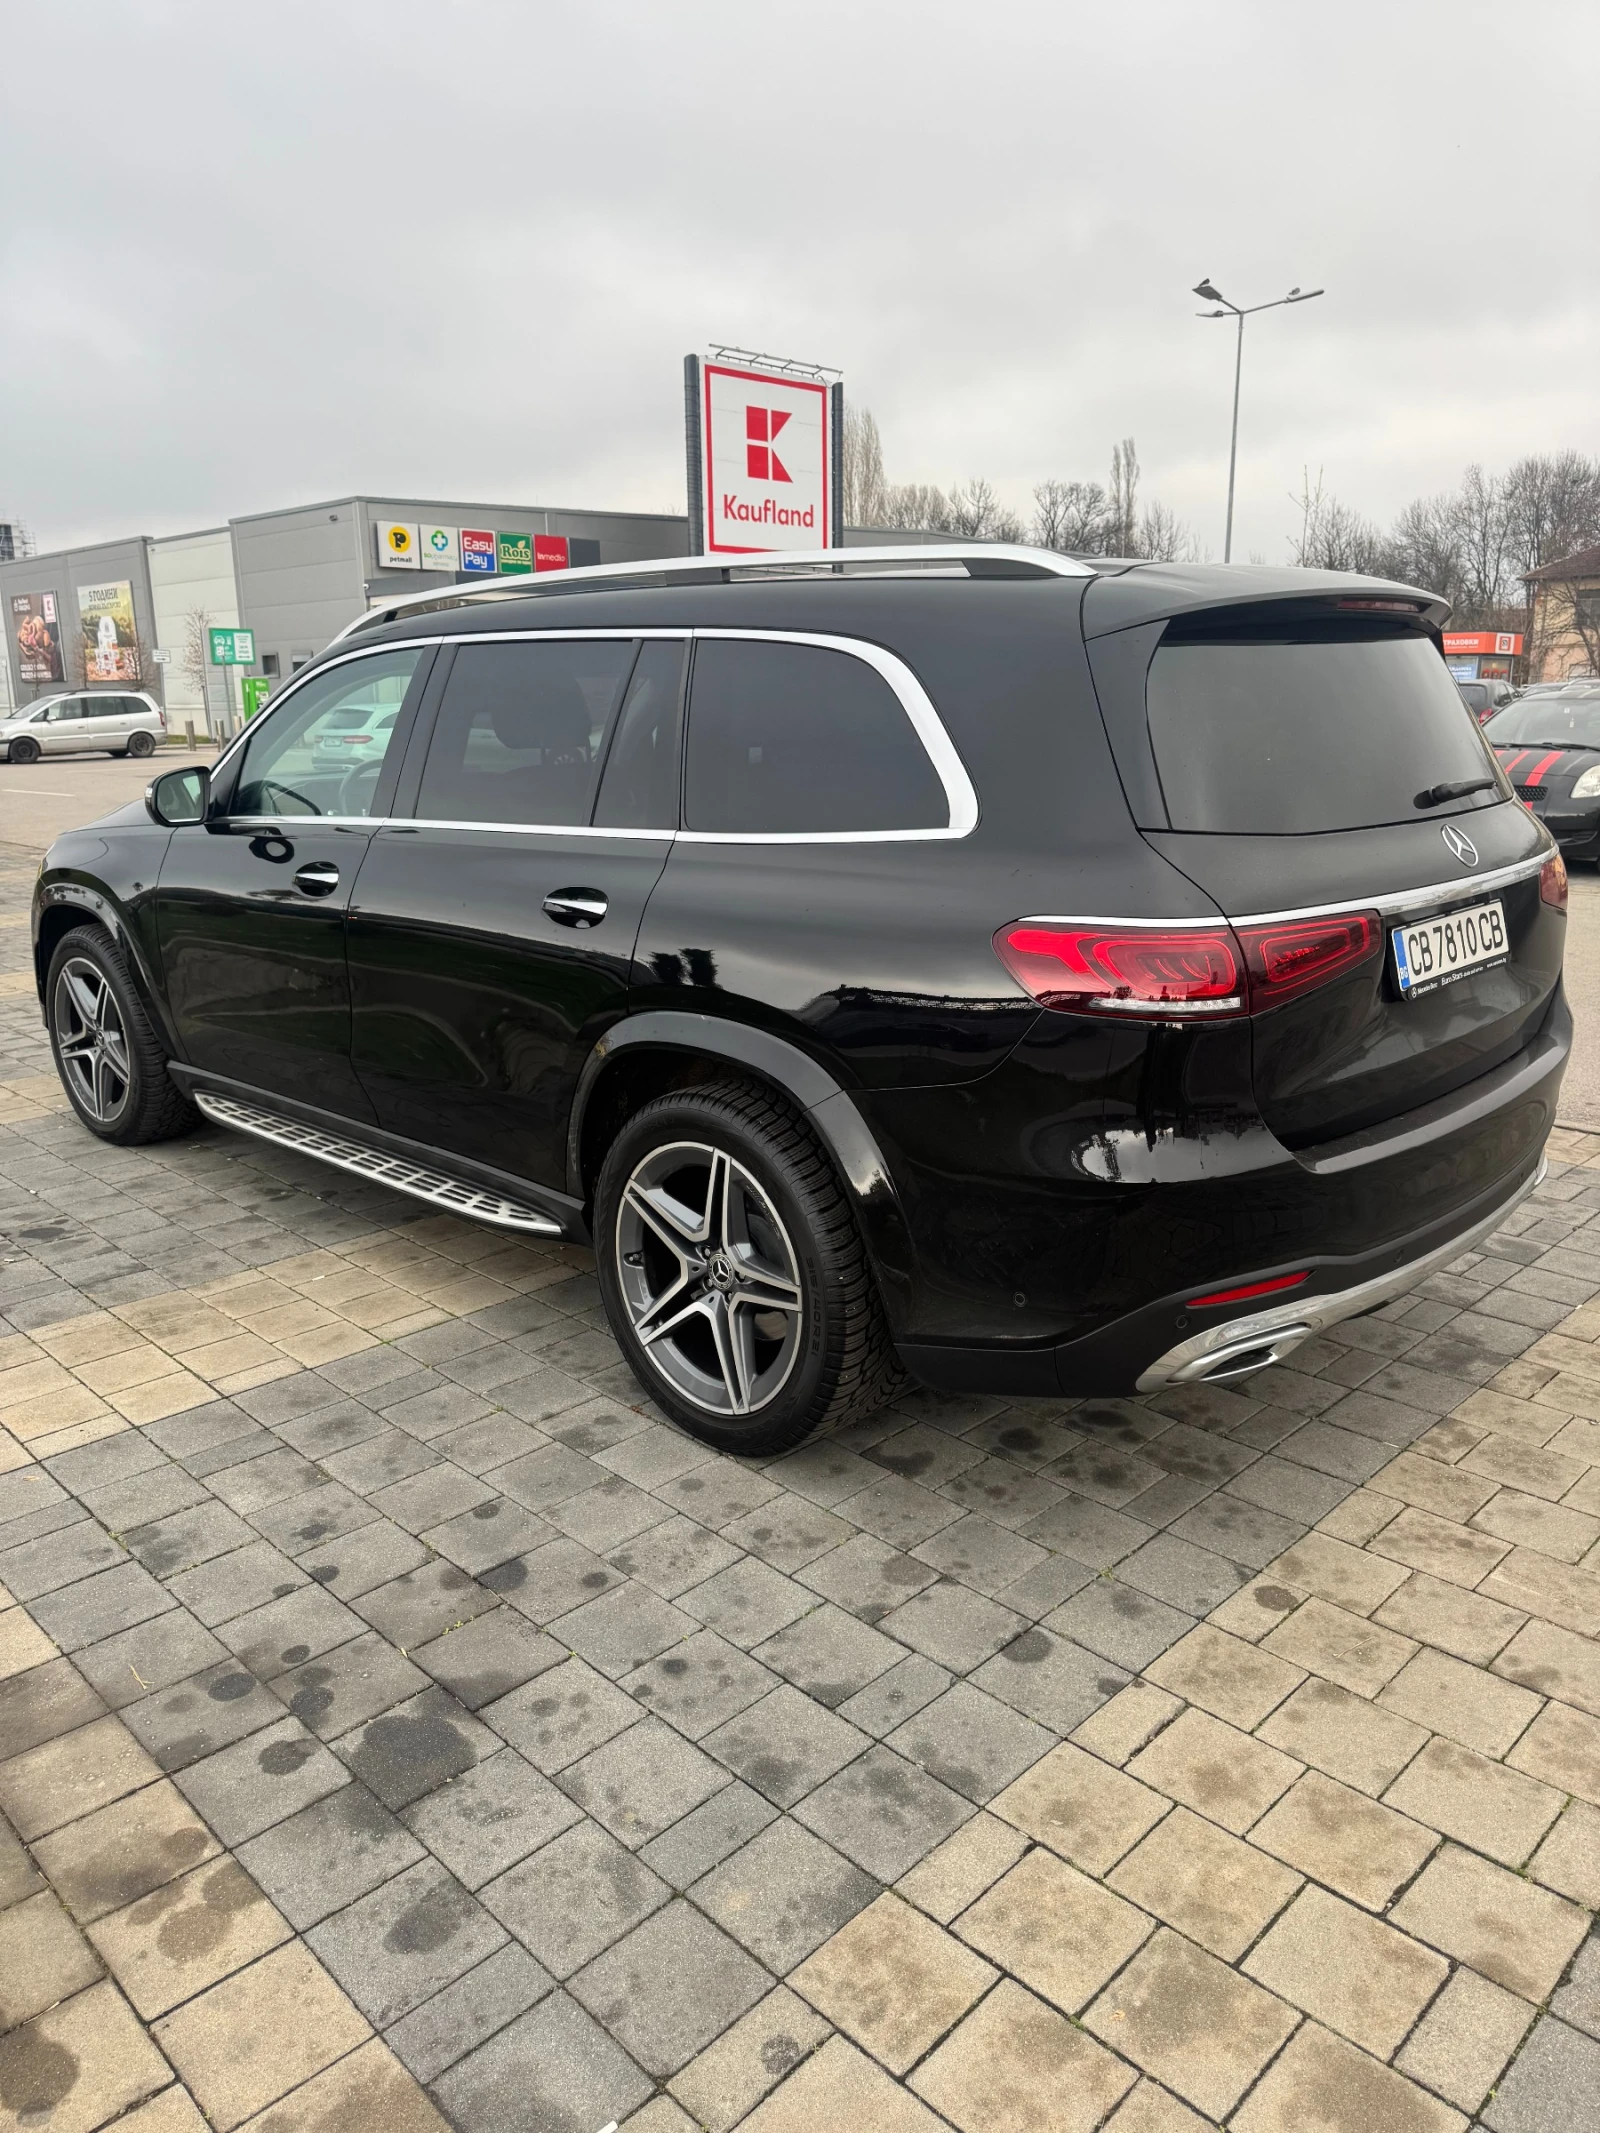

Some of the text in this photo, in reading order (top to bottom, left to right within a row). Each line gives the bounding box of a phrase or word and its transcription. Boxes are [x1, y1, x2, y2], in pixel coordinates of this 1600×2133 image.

[723, 494, 814, 528] Kaufland
[464, 537, 493, 554] Easy
[501, 544, 531, 559] Rois
[464, 551, 488, 569] Pay
[1443, 638, 1479, 646] ТРАХОВКИ
[1400, 966, 1408, 980] BG
